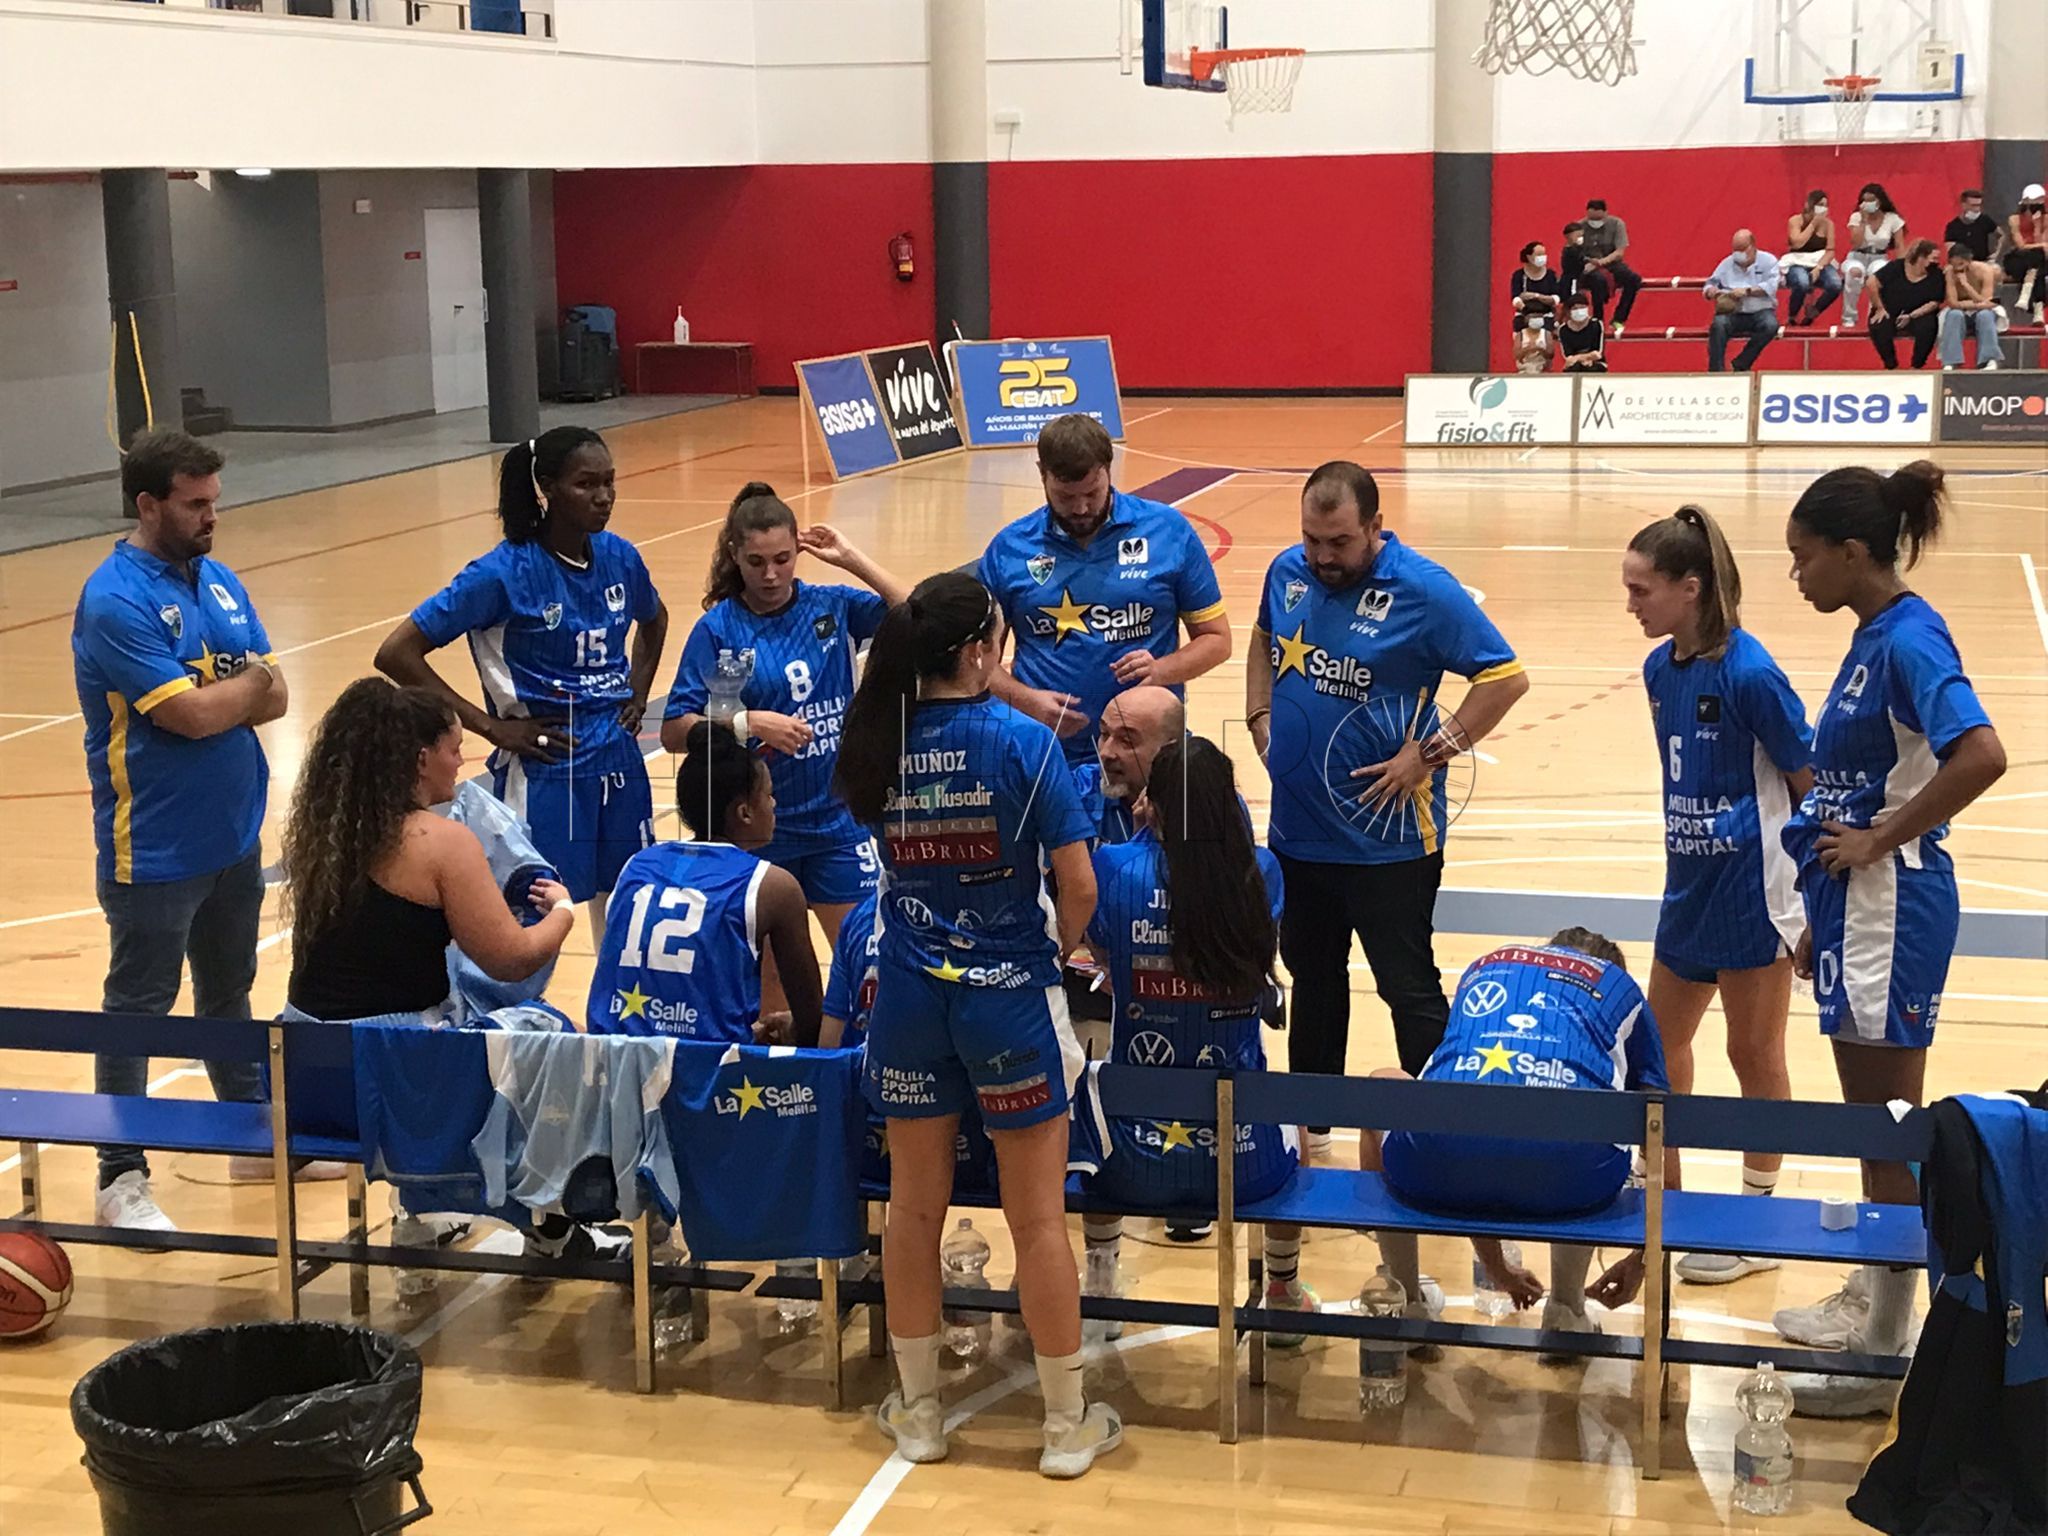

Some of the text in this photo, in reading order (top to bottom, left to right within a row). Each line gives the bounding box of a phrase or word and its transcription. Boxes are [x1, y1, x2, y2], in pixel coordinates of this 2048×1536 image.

[998, 358, 1078, 407] 25
[1010, 389, 1066, 408] CBAT
[1625, 396, 1740, 406] DE VELASCO
[1762, 393, 1891, 424] asisa
[818, 399, 867, 437] asisa
[1619, 412, 1692, 421] ARCHITECTURE
[1705, 412, 1744, 421] DESIGN
[1025, 602, 1154, 635] La Salle
[1104, 625, 1152, 643] Melilla
[573, 627, 608, 668] 15
[1309, 648, 1372, 687] Salle
[784, 659, 813, 703] 8
[1315, 678, 1369, 703] Melilla
[898, 748, 967, 775] MUÑOZ
[1669, 735, 1682, 782] 6
[1667, 794, 1734, 814] MELILLA
[1667, 815, 1716, 836] SPORT
[1668, 836, 1739, 855] CAPITAL
[619, 883, 708, 975] 12
[649, 998, 698, 1024] Salle
[655, 1021, 696, 1035] Melilla
[882, 1066, 936, 1083] MELILLA
[1454, 1053, 1577, 1084] La Salle
[881, 1091, 937, 1105] CAPITAL
[882, 1079, 925, 1093] SPORT
[714, 1084, 814, 1115] La Salle
[777, 1104, 818, 1118] Melilla
[1135, 1125, 1162, 1146] La
